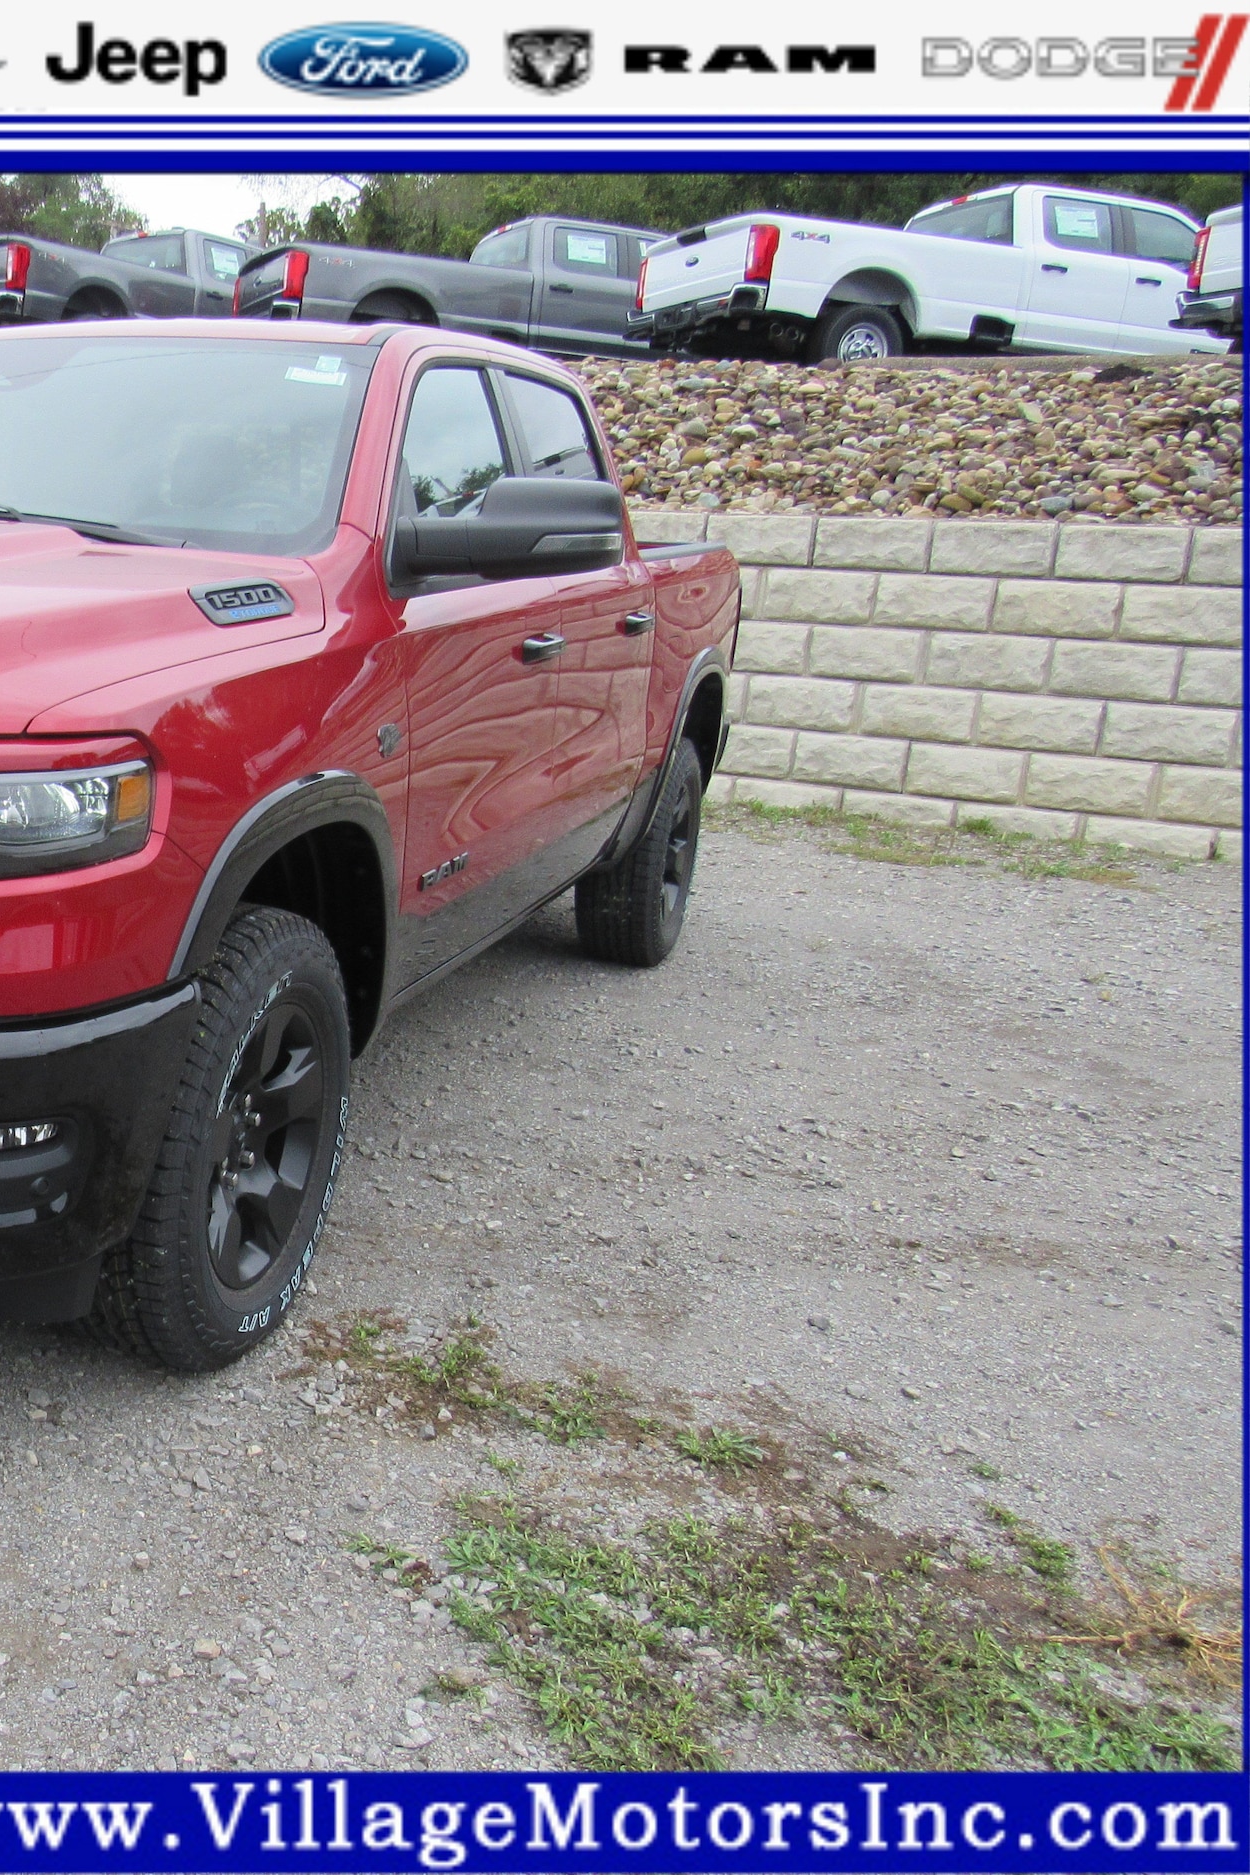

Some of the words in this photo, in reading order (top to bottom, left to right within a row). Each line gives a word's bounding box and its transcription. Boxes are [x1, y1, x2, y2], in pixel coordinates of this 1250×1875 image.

[207, 586, 276, 609] 1500
[421, 850, 470, 892] RAM
[279, 1096, 349, 1312] WILDPEAK
[237, 1305, 271, 1334] A/T
